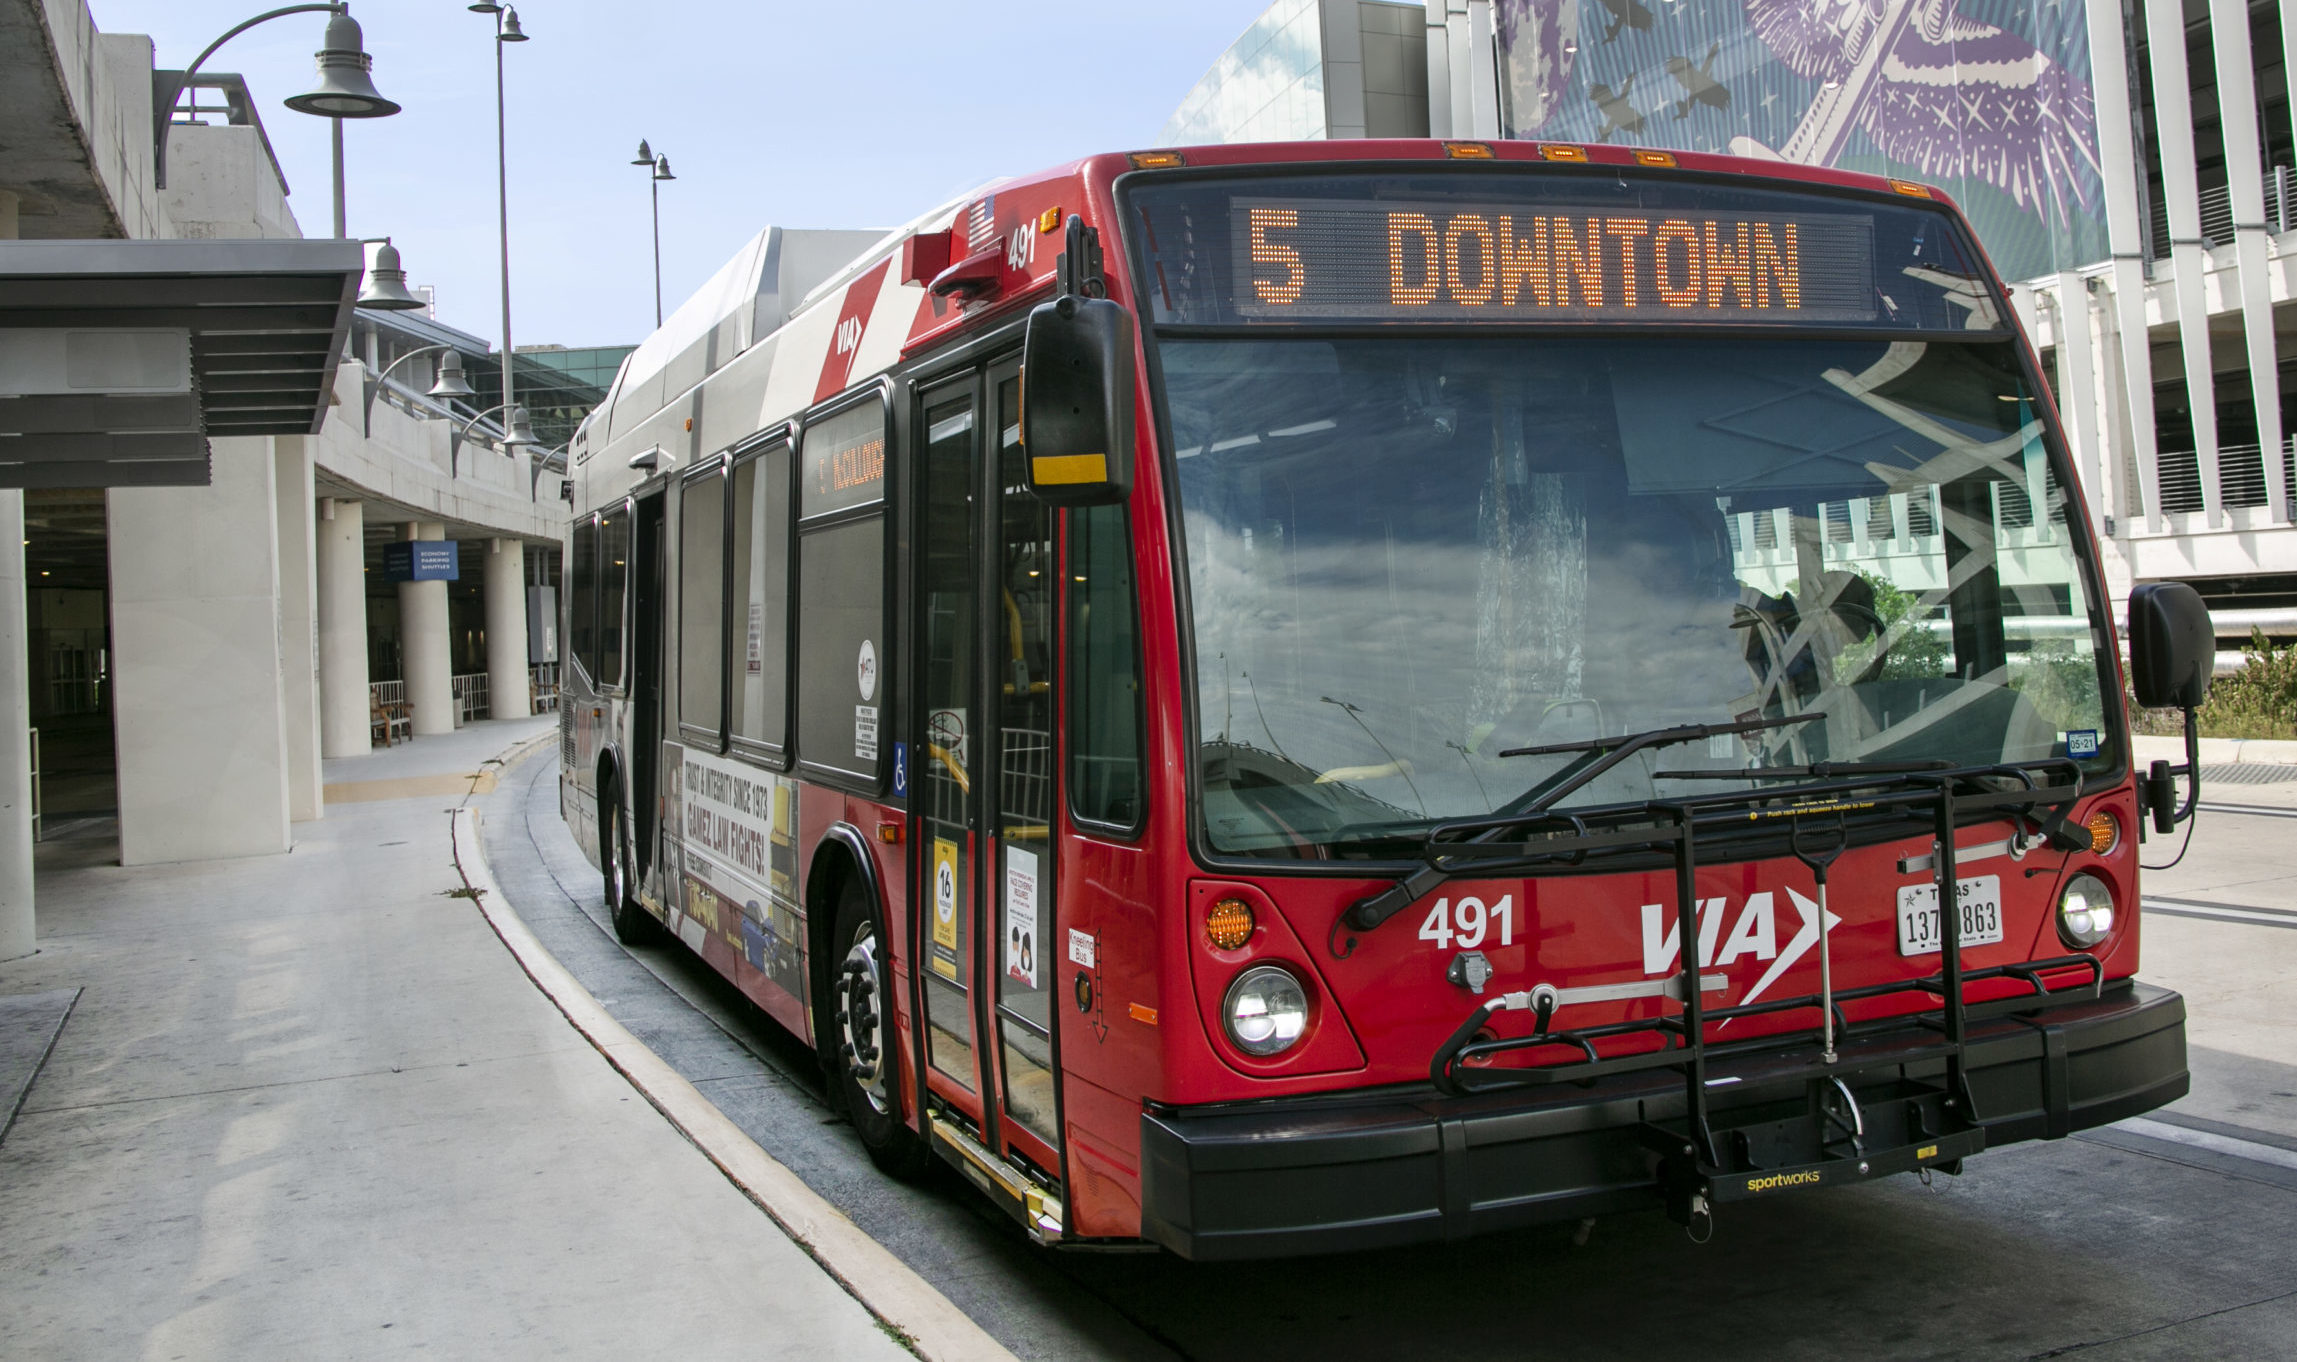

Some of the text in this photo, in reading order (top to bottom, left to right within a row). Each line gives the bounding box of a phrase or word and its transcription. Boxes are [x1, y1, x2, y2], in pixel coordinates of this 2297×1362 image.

[1007, 217, 1037, 272] 491
[1249, 208, 1801, 309] 5 DOWNTOWN
[685, 760, 700, 794] TRUST
[705, 767, 733, 807] INTEGRITY
[733, 776, 751, 815] SINCE
[752, 783, 768, 822] 1973
[712, 812, 729, 857] LAW
[731, 820, 765, 878] FIGHTS!
[939, 868, 951, 899] 16
[1930, 884, 1970, 901] TAS
[1069, 931, 1094, 955] Kneeling
[1418, 894, 1513, 950] 491
[1641, 891, 1777, 975] VIA
[1075, 947, 1087, 963] Bus
[1747, 1170, 1821, 1192] sportworks
